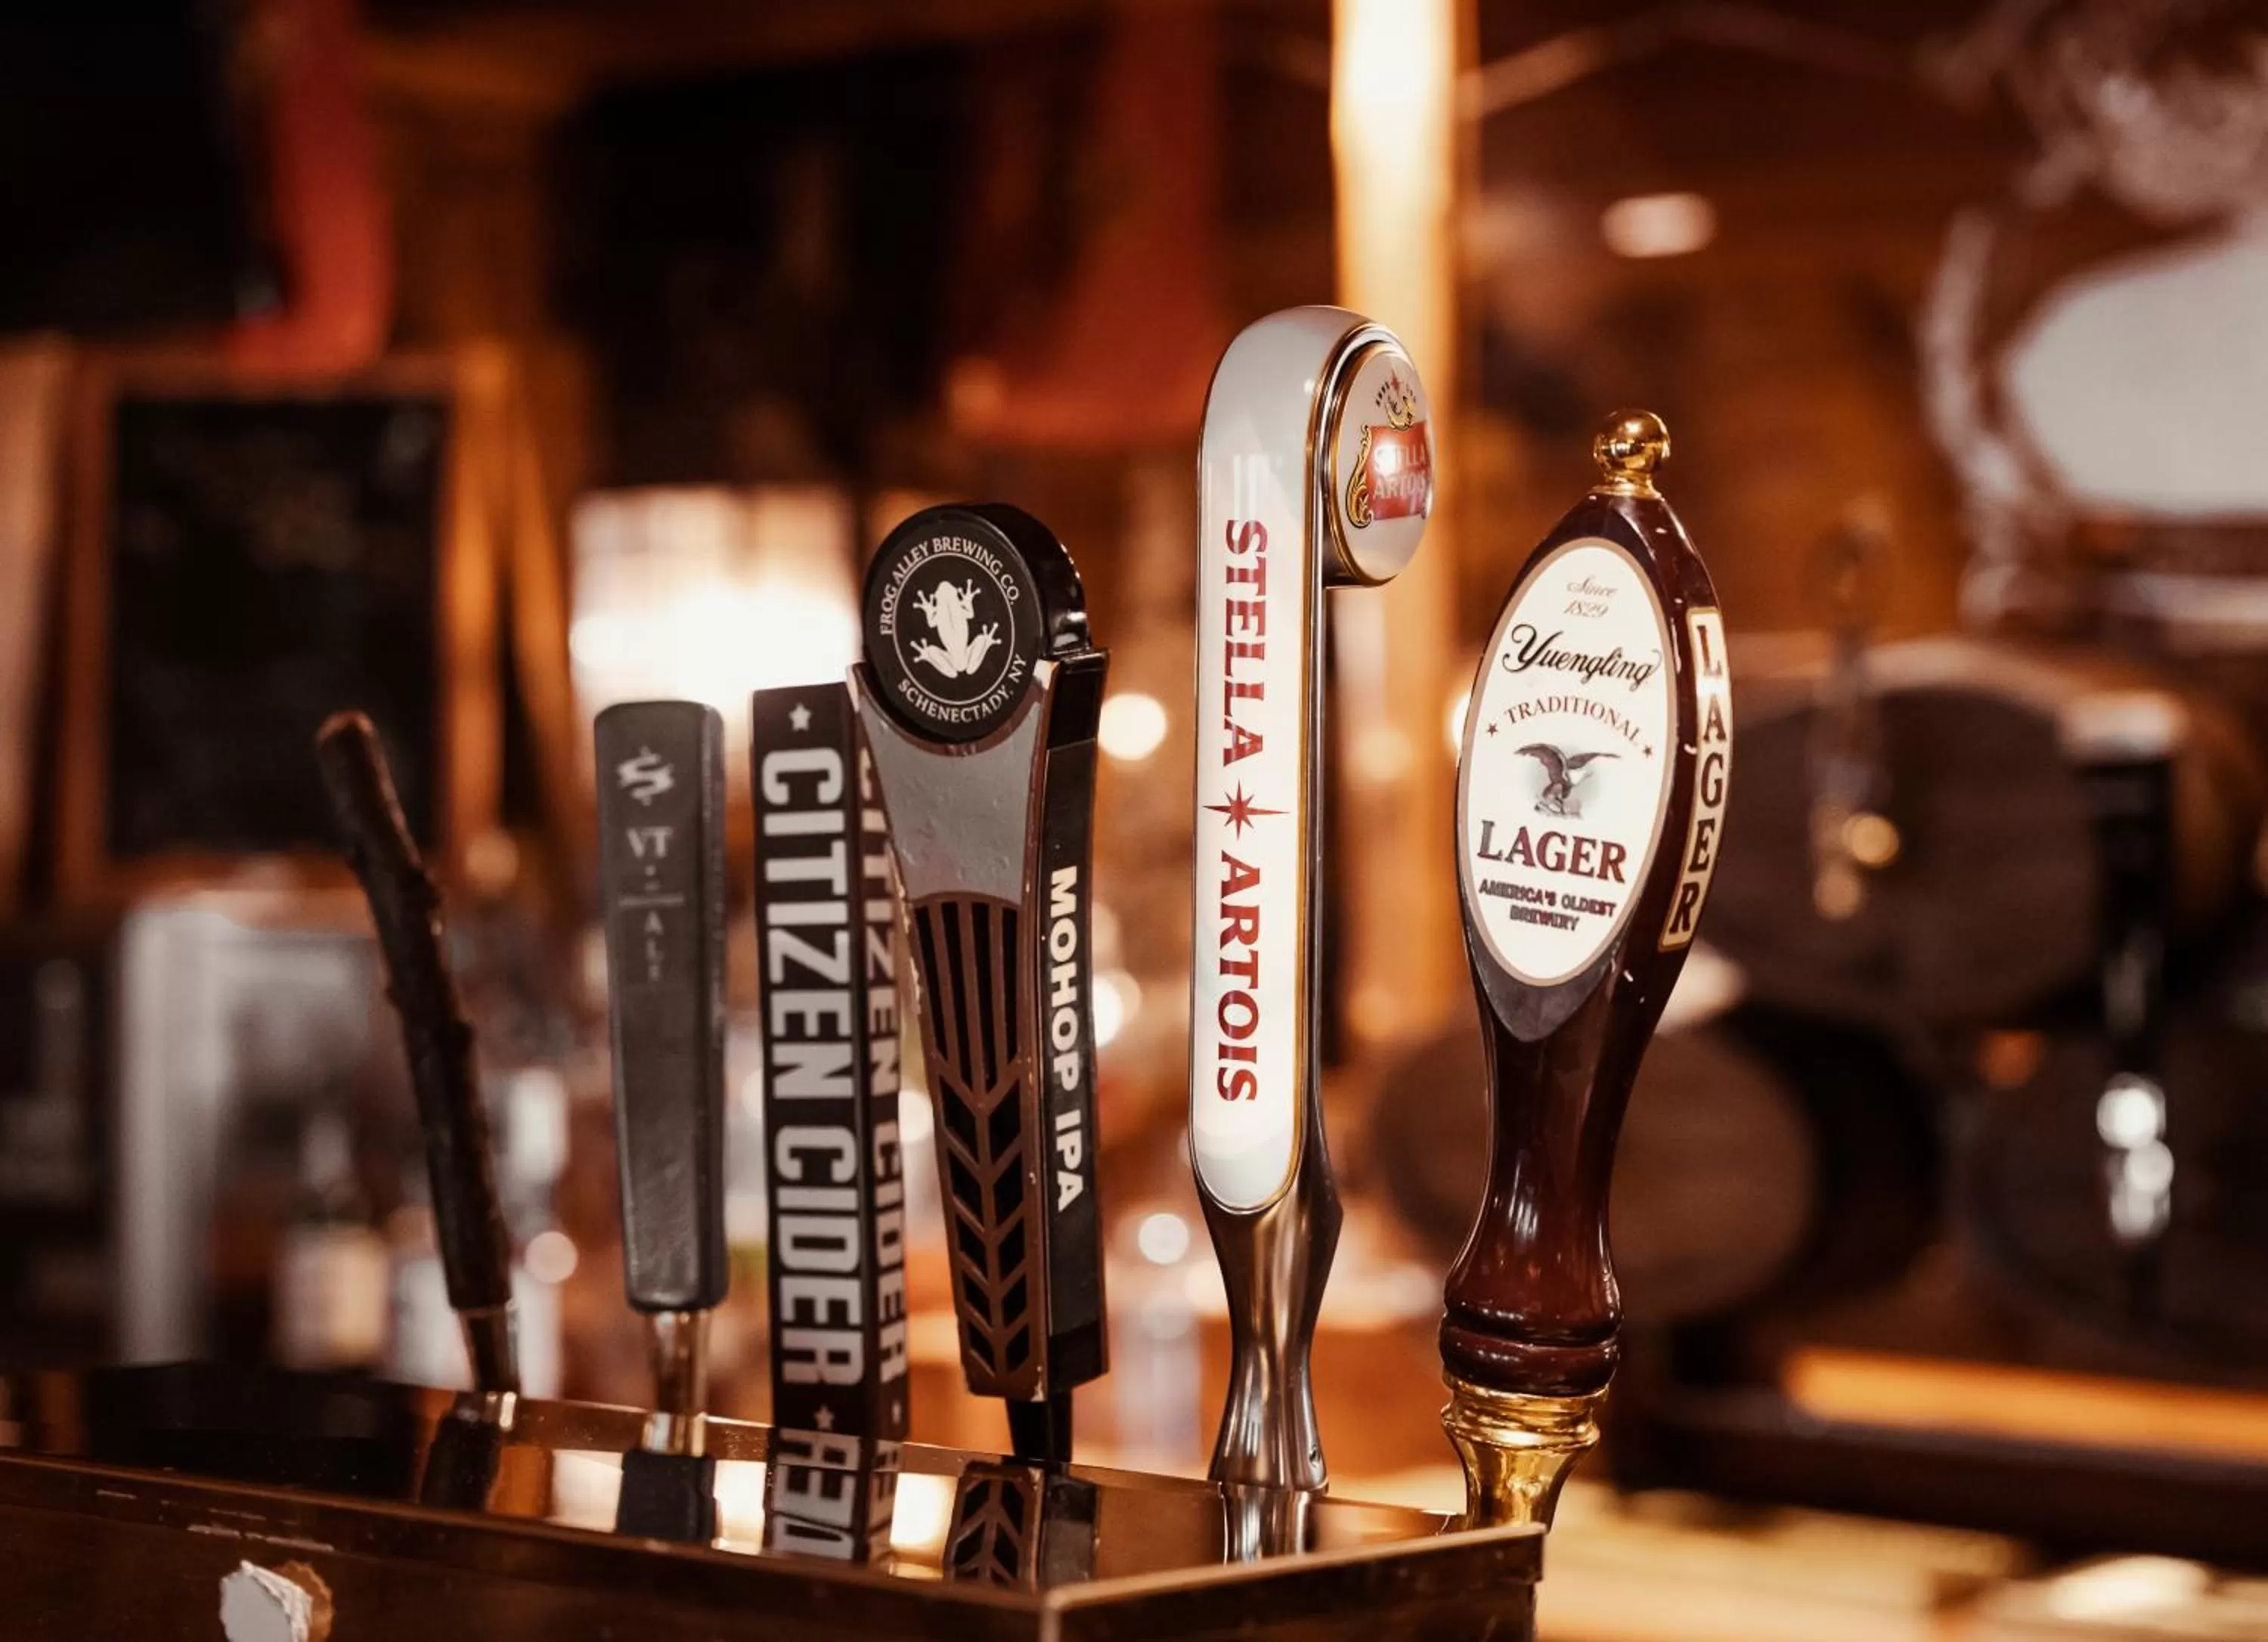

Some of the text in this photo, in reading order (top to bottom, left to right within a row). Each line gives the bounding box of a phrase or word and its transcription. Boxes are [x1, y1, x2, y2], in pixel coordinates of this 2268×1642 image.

[1374, 443, 1427, 472] SLLA
[879, 536, 1020, 635] FROG ALLEY BREWING CO.
[1563, 599, 1609, 618] 1829
[1566, 575, 1619, 596] Since
[897, 653, 1027, 723] SCHENECTADY, NY
[1502, 623, 1662, 692] Yuengling
[1503, 695, 1641, 746] TRADITIONAL
[1217, 519, 1268, 1101] STELLA ARTOIS
[1668, 624, 1727, 935] LAGER
[1476, 819, 1627, 883] LAGER
[1479, 878, 1617, 918] AMERICA'S OLDEST
[761, 748, 866, 1386] CITIZEN CIDER
[1049, 865, 1085, 1213] MOHOP IPA
[874, 1120, 907, 1384] CIDER
